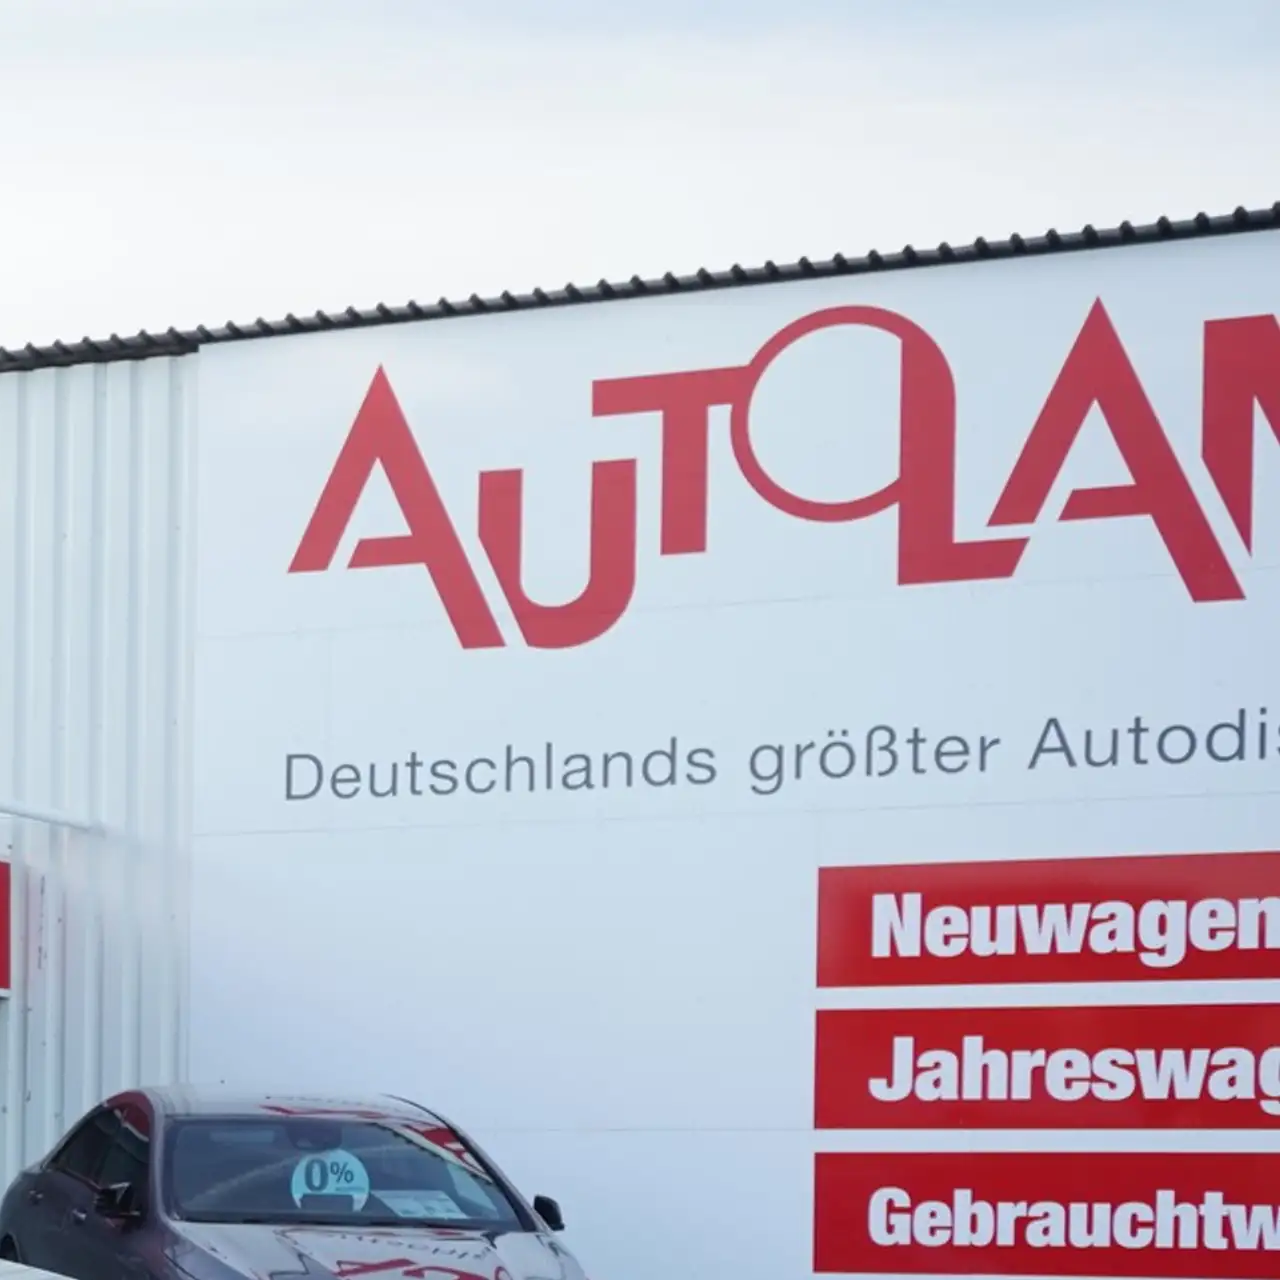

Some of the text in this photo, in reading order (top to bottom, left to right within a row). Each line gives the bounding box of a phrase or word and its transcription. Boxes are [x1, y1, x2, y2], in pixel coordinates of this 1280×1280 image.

[284, 706, 1280, 802] Deutschlands größter Autodi
[871, 892, 1280, 968] Neuwagen
[304, 1157, 354, 1194] 0%
[867, 1187, 1280, 1250] Gebrauchtw
